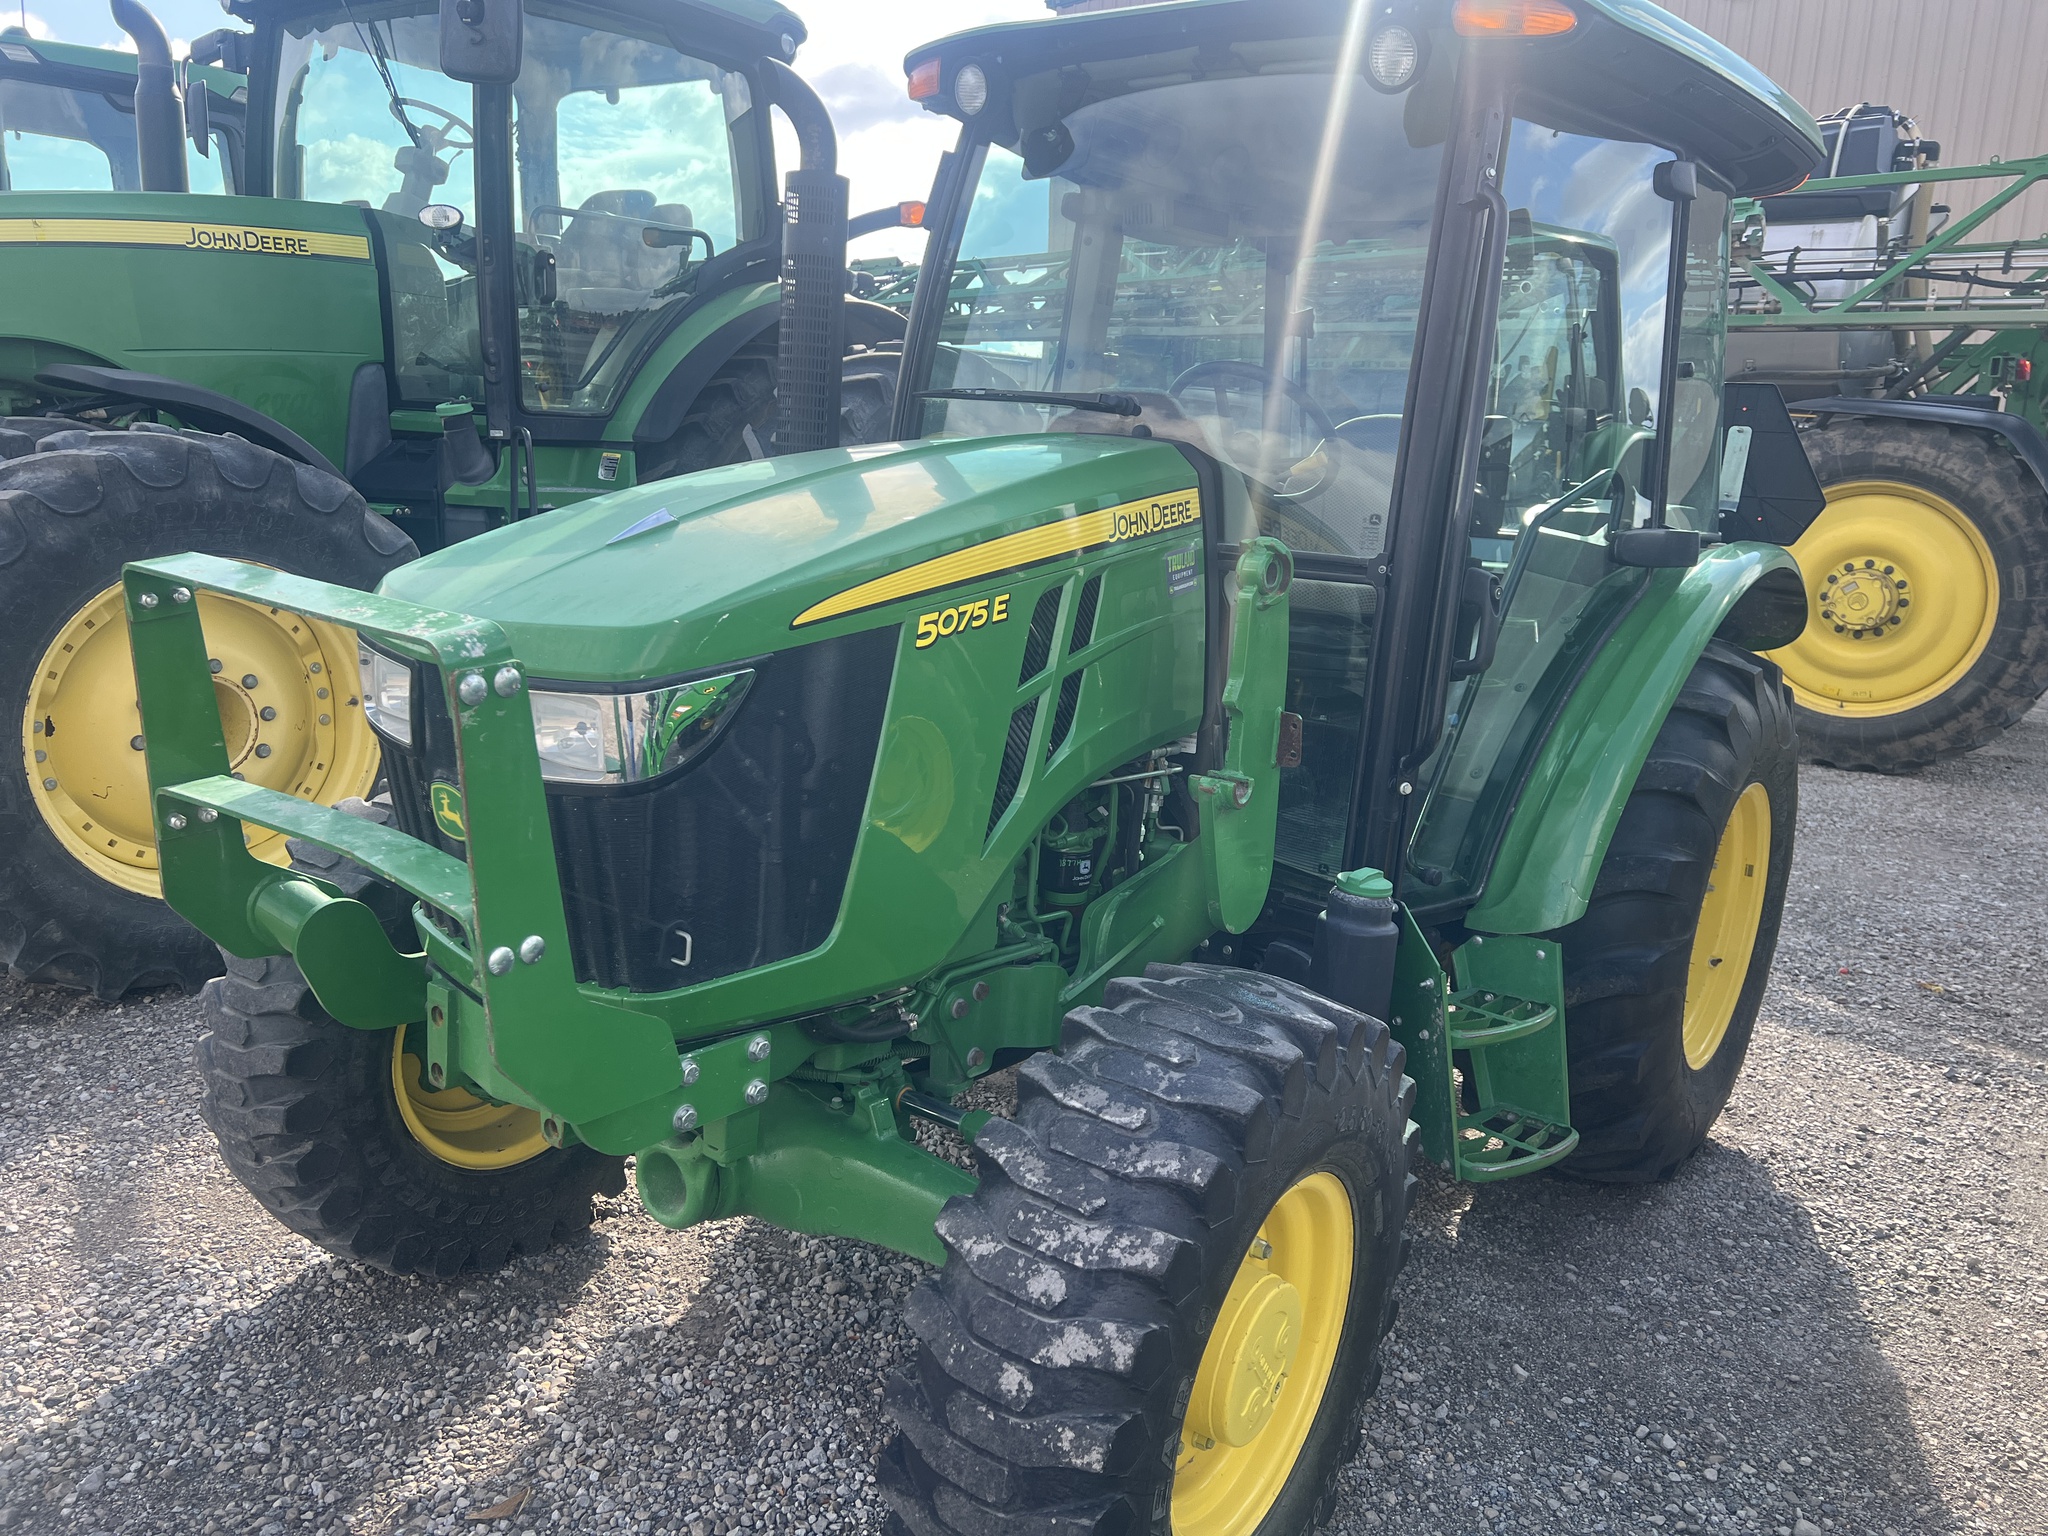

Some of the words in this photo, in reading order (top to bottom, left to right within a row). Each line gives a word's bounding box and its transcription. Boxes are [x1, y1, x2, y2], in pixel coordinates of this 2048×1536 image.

[185, 226, 242, 250] JOHN
[243, 230, 311, 254] DEERE
[1108, 511, 1150, 541] JOHN
[1151, 500, 1193, 531] DEERE
[1172, 569, 1193, 581] EQUIPMENT
[915, 598, 990, 650] 5075
[991, 593, 1011, 624] E
